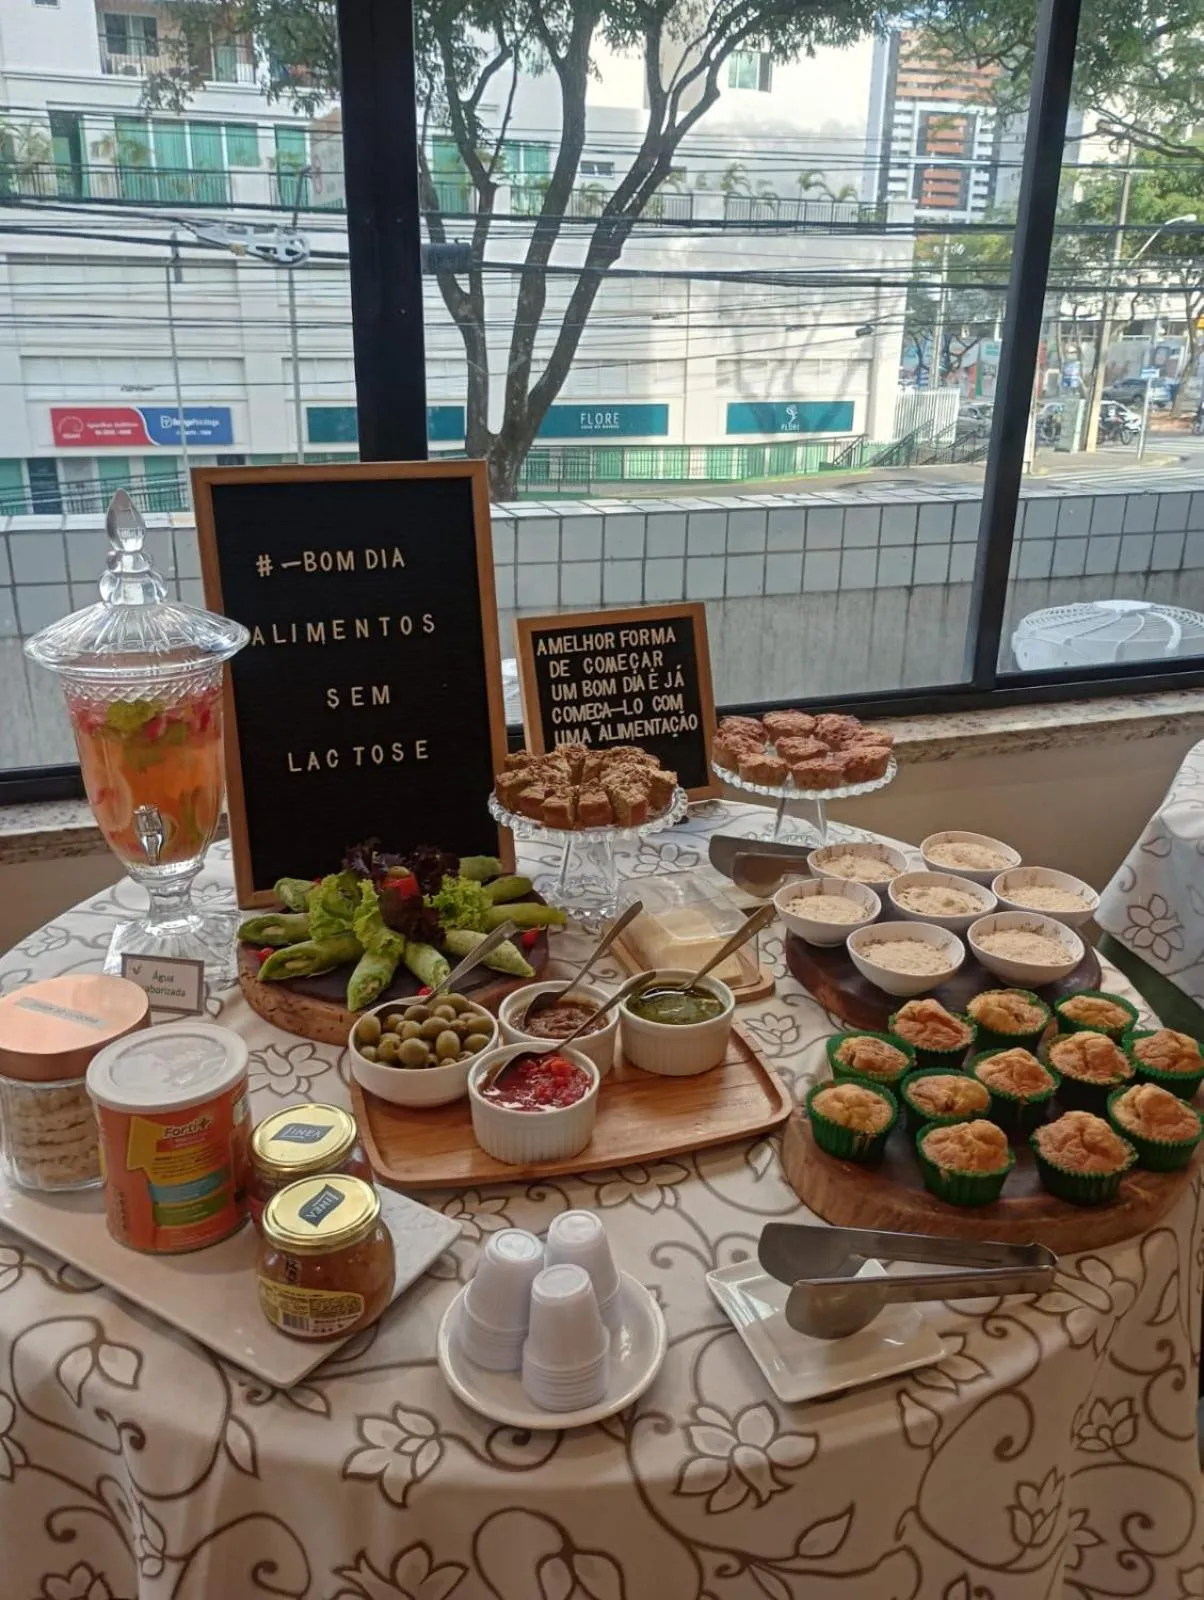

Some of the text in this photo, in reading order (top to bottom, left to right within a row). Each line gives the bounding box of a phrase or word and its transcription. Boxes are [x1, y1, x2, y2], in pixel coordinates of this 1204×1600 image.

[580, 412, 620, 425] FLORE
[365, 547, 405, 570] DIA
[251, 613, 436, 646] ALIMENTOS
[620, 626, 676, 647] FORMA
[549, 650, 663, 678] DE COMEÇAR
[551, 682, 578, 701] UM
[582, 678, 617, 698] BOM
[622, 674, 645, 693] DIA
[663, 664, 685, 688] JÁ
[326, 685, 390, 709] SEM
[652, 694, 684, 712] COM
[554, 727, 592, 745] UMA
[144, 984, 186, 998] aborizada
